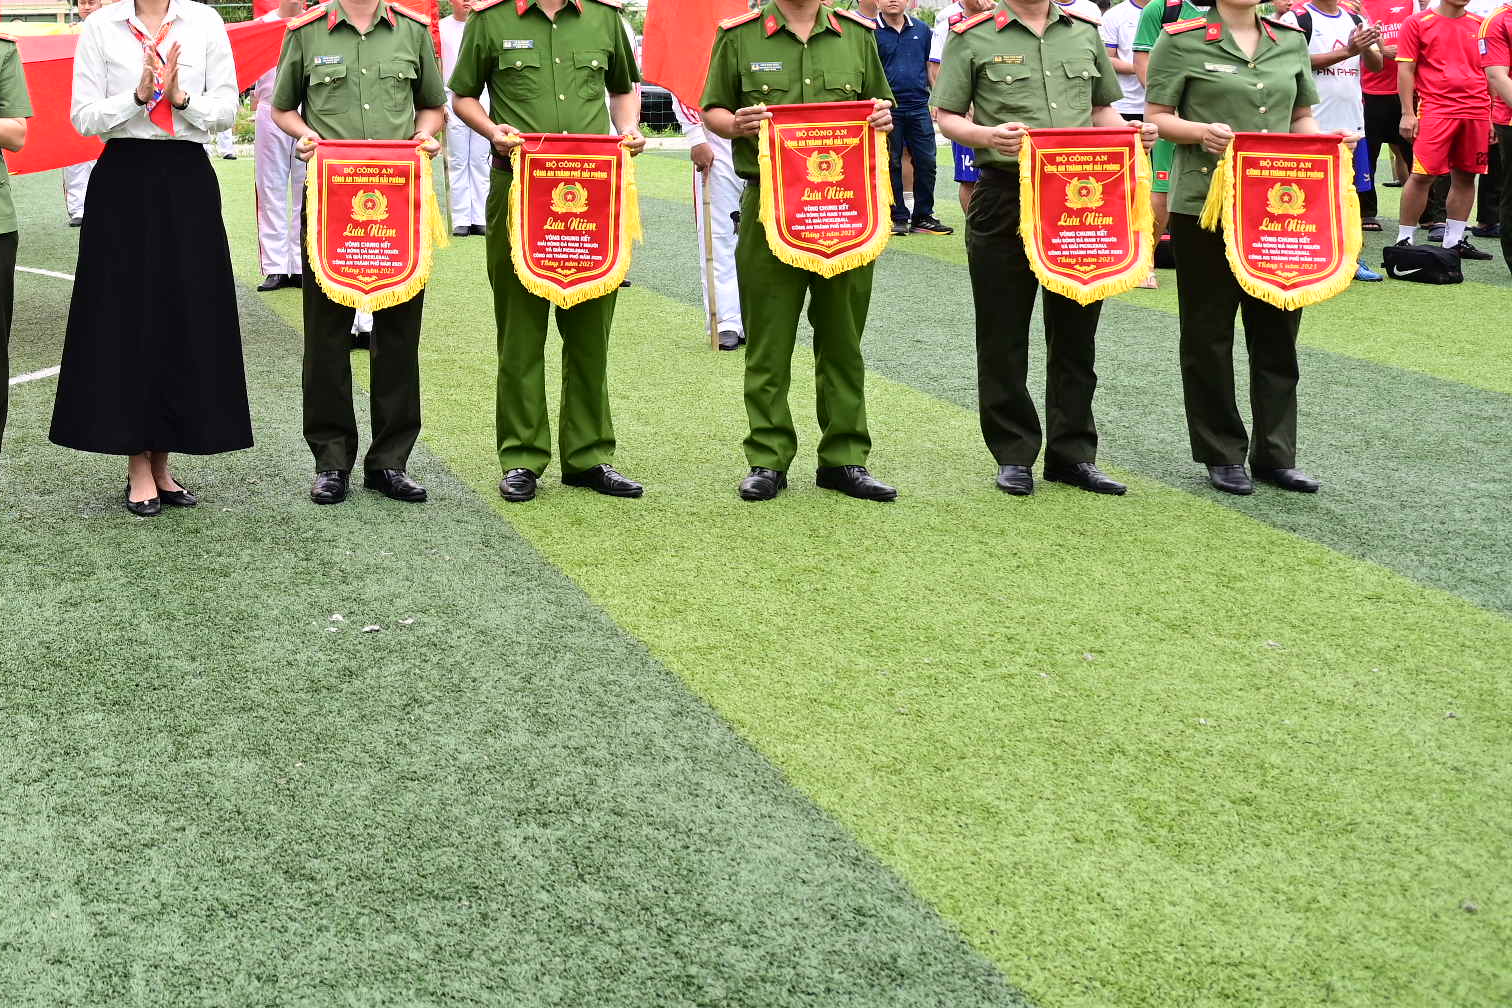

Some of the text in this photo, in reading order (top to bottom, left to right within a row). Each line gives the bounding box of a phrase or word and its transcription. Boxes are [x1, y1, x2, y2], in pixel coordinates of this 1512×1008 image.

[546, 160, 557, 168] BỘ
[825, 186, 854, 203] Niệm
[568, 217, 597, 234] Niệm
[1083, 212, 1113, 229] Niệm
[1285, 218, 1316, 236] Niệm
[368, 224, 396, 240] Niệm
